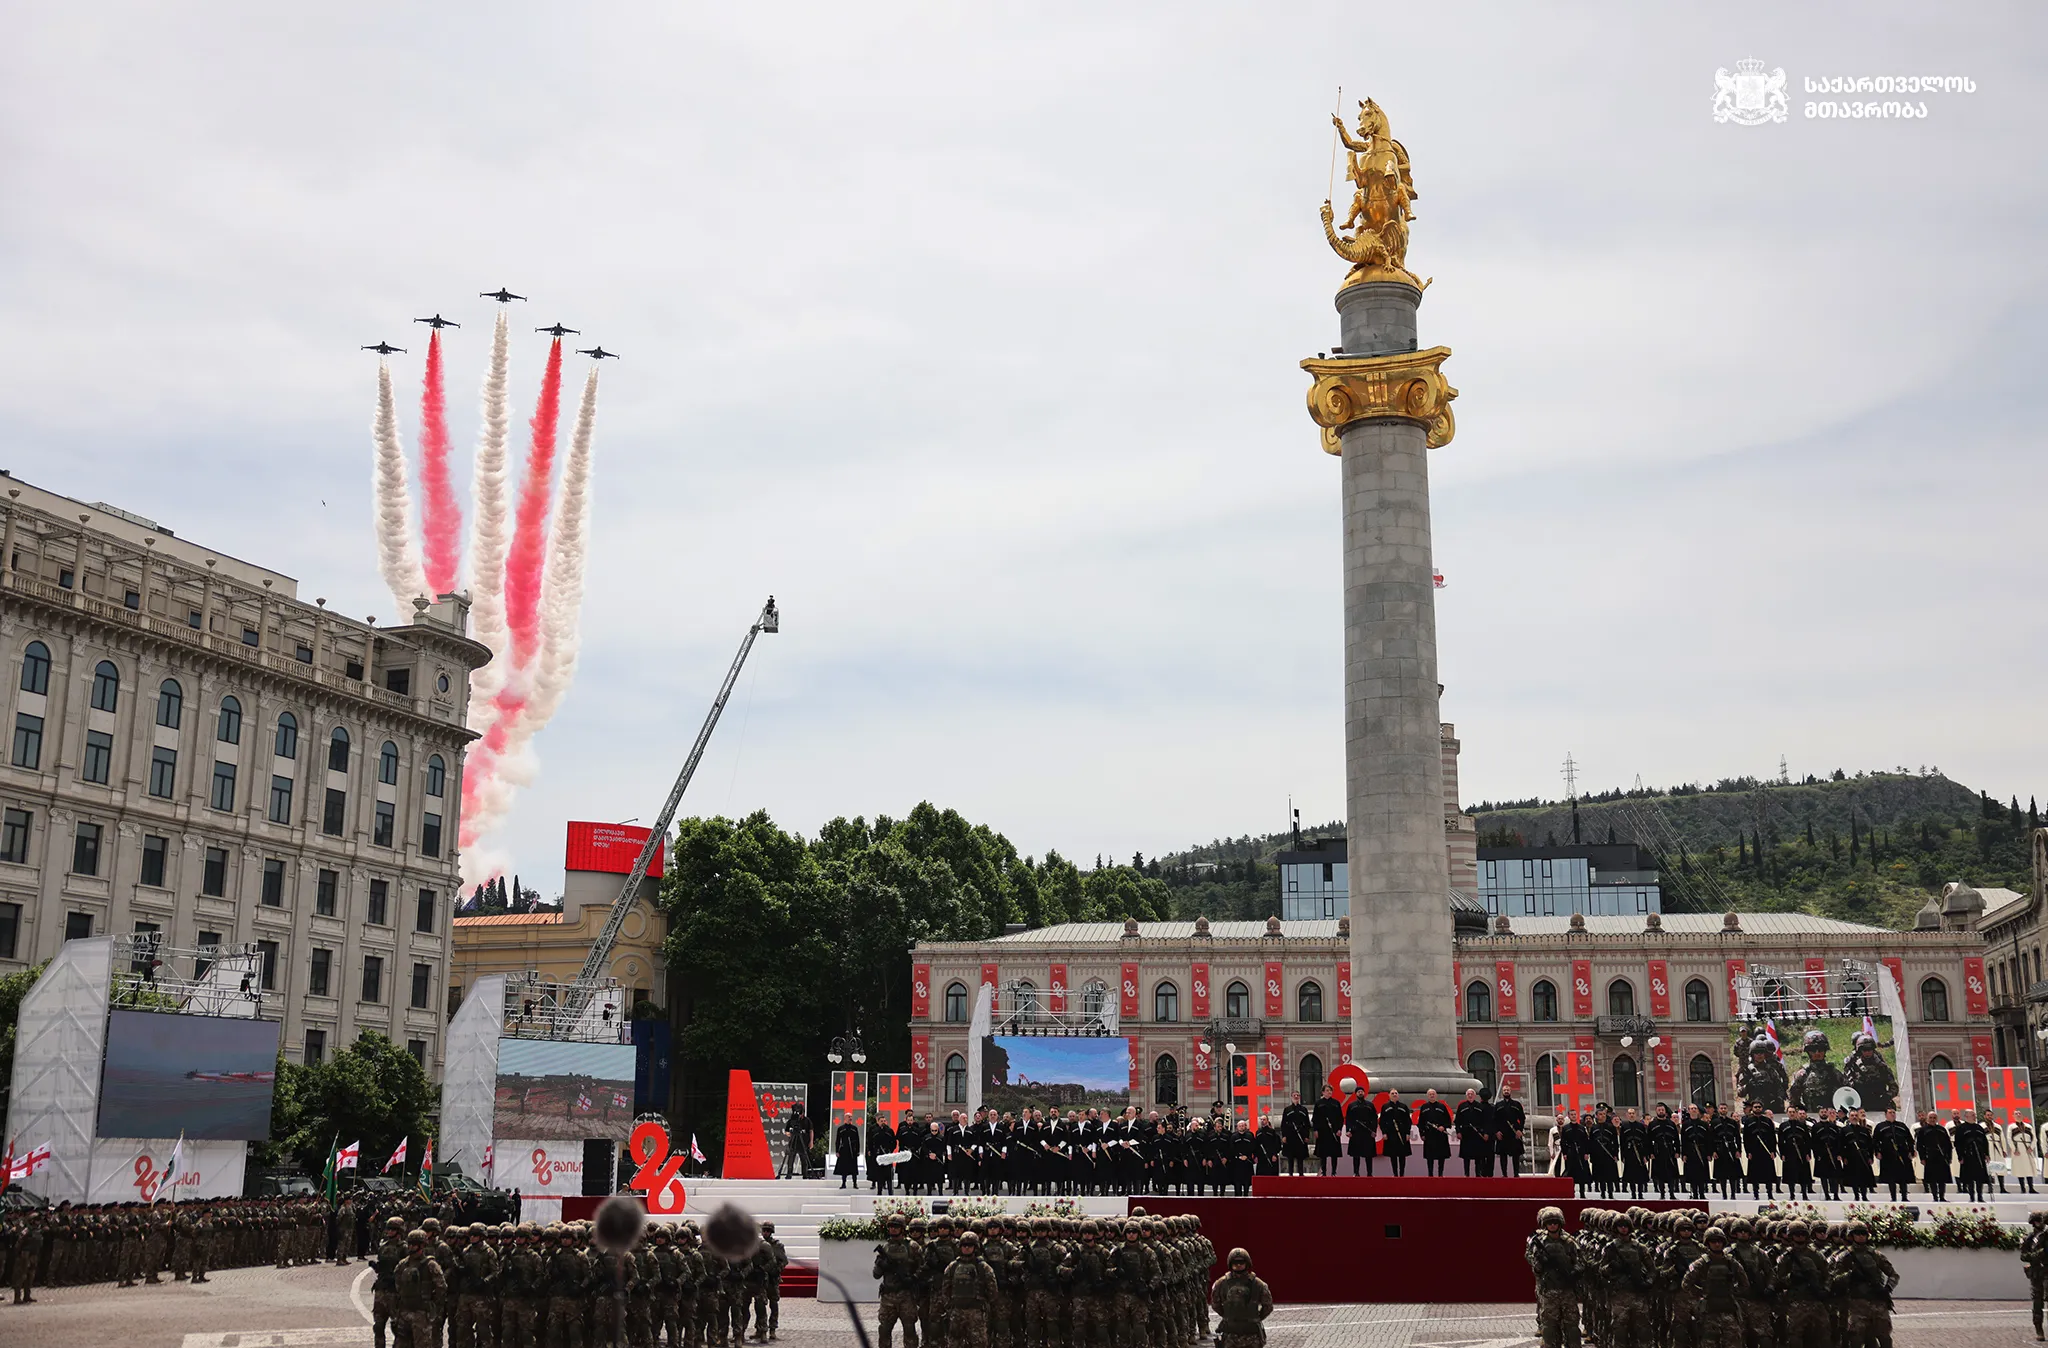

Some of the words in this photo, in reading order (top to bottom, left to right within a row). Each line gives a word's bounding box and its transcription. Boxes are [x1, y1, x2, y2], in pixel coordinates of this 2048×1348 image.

[915, 981, 927, 998] 26
[1124, 980, 1136, 998] 26
[1194, 980, 1206, 997] 26
[1268, 980, 1280, 997] 26
[1499, 979, 1513, 997] 26
[1576, 978, 1589, 996] 26
[1652, 978, 1666, 996] 26
[1968, 976, 1983, 994] 26
[914, 1052, 926, 1069] 26
[1196, 1053, 1208, 1070] 26
[1503, 1054, 1516, 1071] 26
[1657, 1054, 1670, 1072] 26
[532, 1149, 552, 1186] 26
[629, 1122, 686, 1214] 26
[133, 1155, 160, 1202] 26
